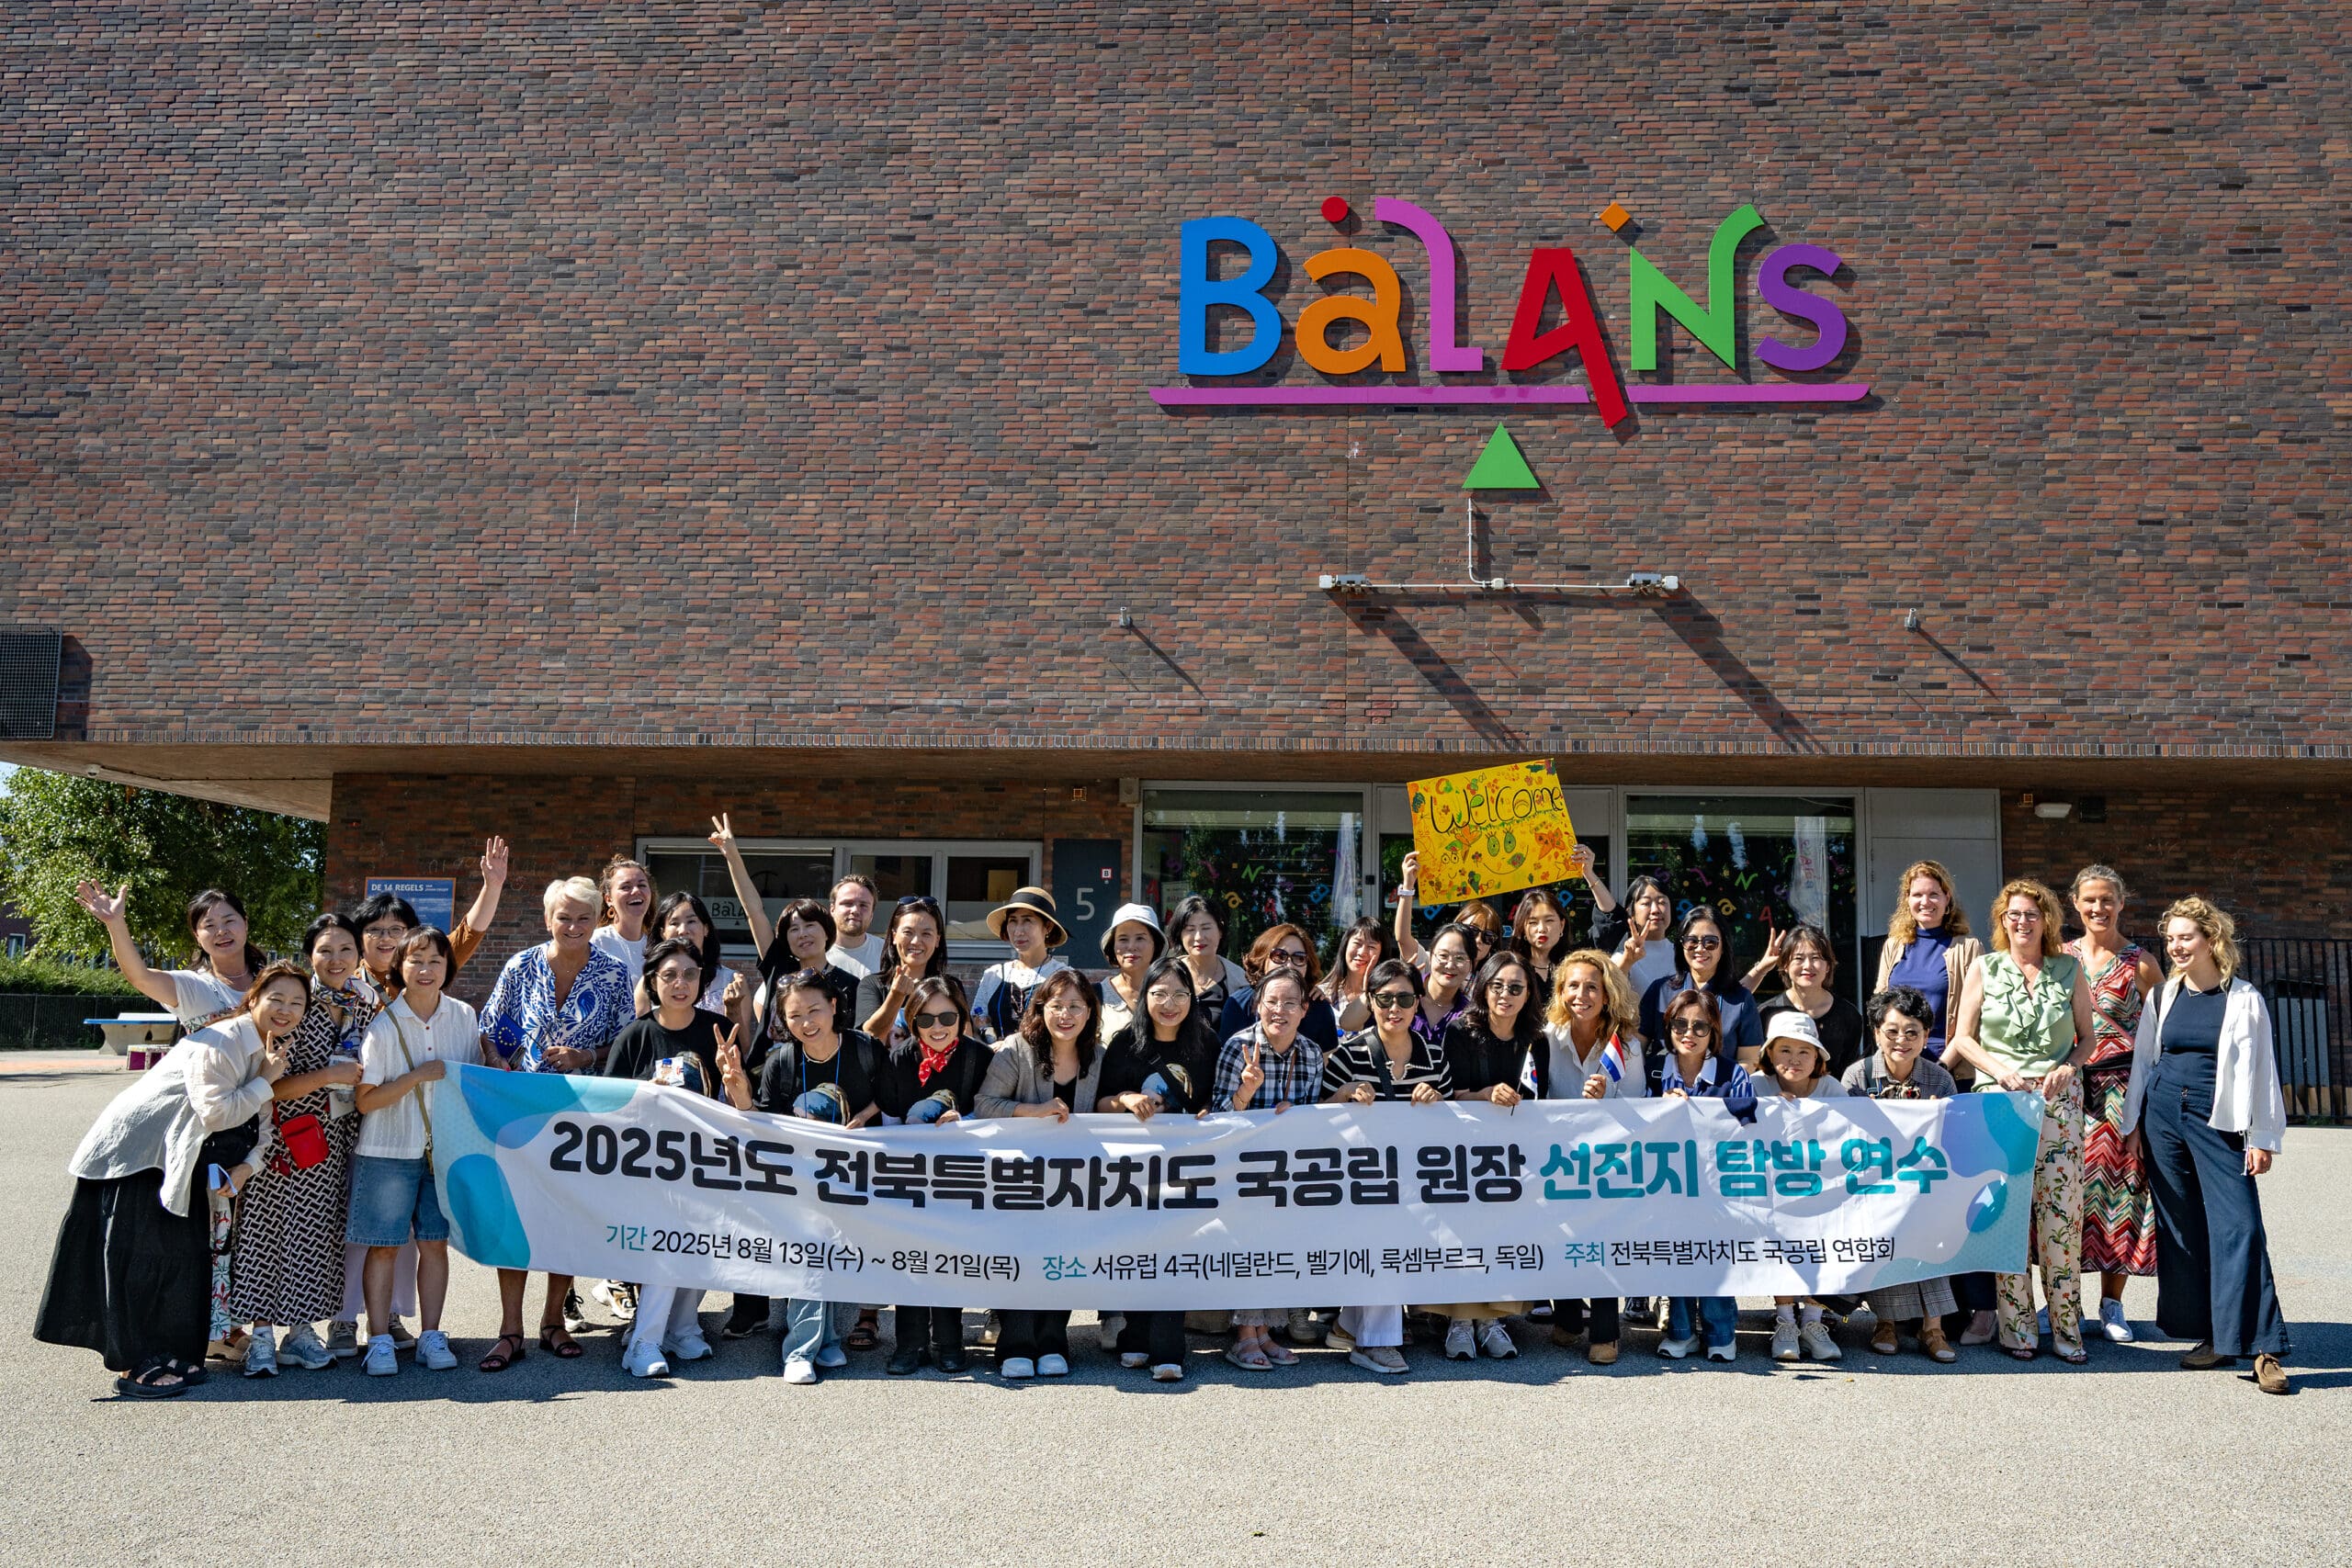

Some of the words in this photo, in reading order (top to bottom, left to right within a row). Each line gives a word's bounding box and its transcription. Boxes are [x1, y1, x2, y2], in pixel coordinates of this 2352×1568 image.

[371, 884, 382, 892] DE
[384, 884, 393, 892] 14
[395, 884, 424, 892] REGELS
[1076, 887, 1095, 920] 5
[550, 1121, 797, 1196] 2025년도
[814, 1148, 1219, 1212] 전북특별자치도
[1235, 1145, 1400, 1208] 국공립
[1416, 1143, 1526, 1204] 원장
[1539, 1139, 1700, 1201] 선진지
[1715, 1138, 1826, 1198] 탐방
[1840, 1137, 1949, 1195] 연수
[605, 1224, 649, 1253] 기간
[650, 1229, 732, 1260] 2025년
[737, 1236, 773, 1264] 8월
[778, 1241, 865, 1273] 13일(수)
[891, 1249, 929, 1275] 8월
[933, 1253, 1021, 1282] 21일(목)
[1042, 1254, 1088, 1281] 장소
[1091, 1252, 1159, 1281] 서유럽
[1163, 1250, 1301, 1281] 4국(네덜란드,
[1306, 1247, 1375, 1279] 벨기에,
[1380, 1247, 1490, 1275] 룩셈부르크,
[1494, 1243, 1544, 1271] 독일)
[1564, 1241, 1606, 1269] 주최
[1610, 1238, 1758, 1267] 전북특별자치도
[1762, 1238, 1827, 1265] 국공립
[1832, 1235, 1895, 1264] 연합회
